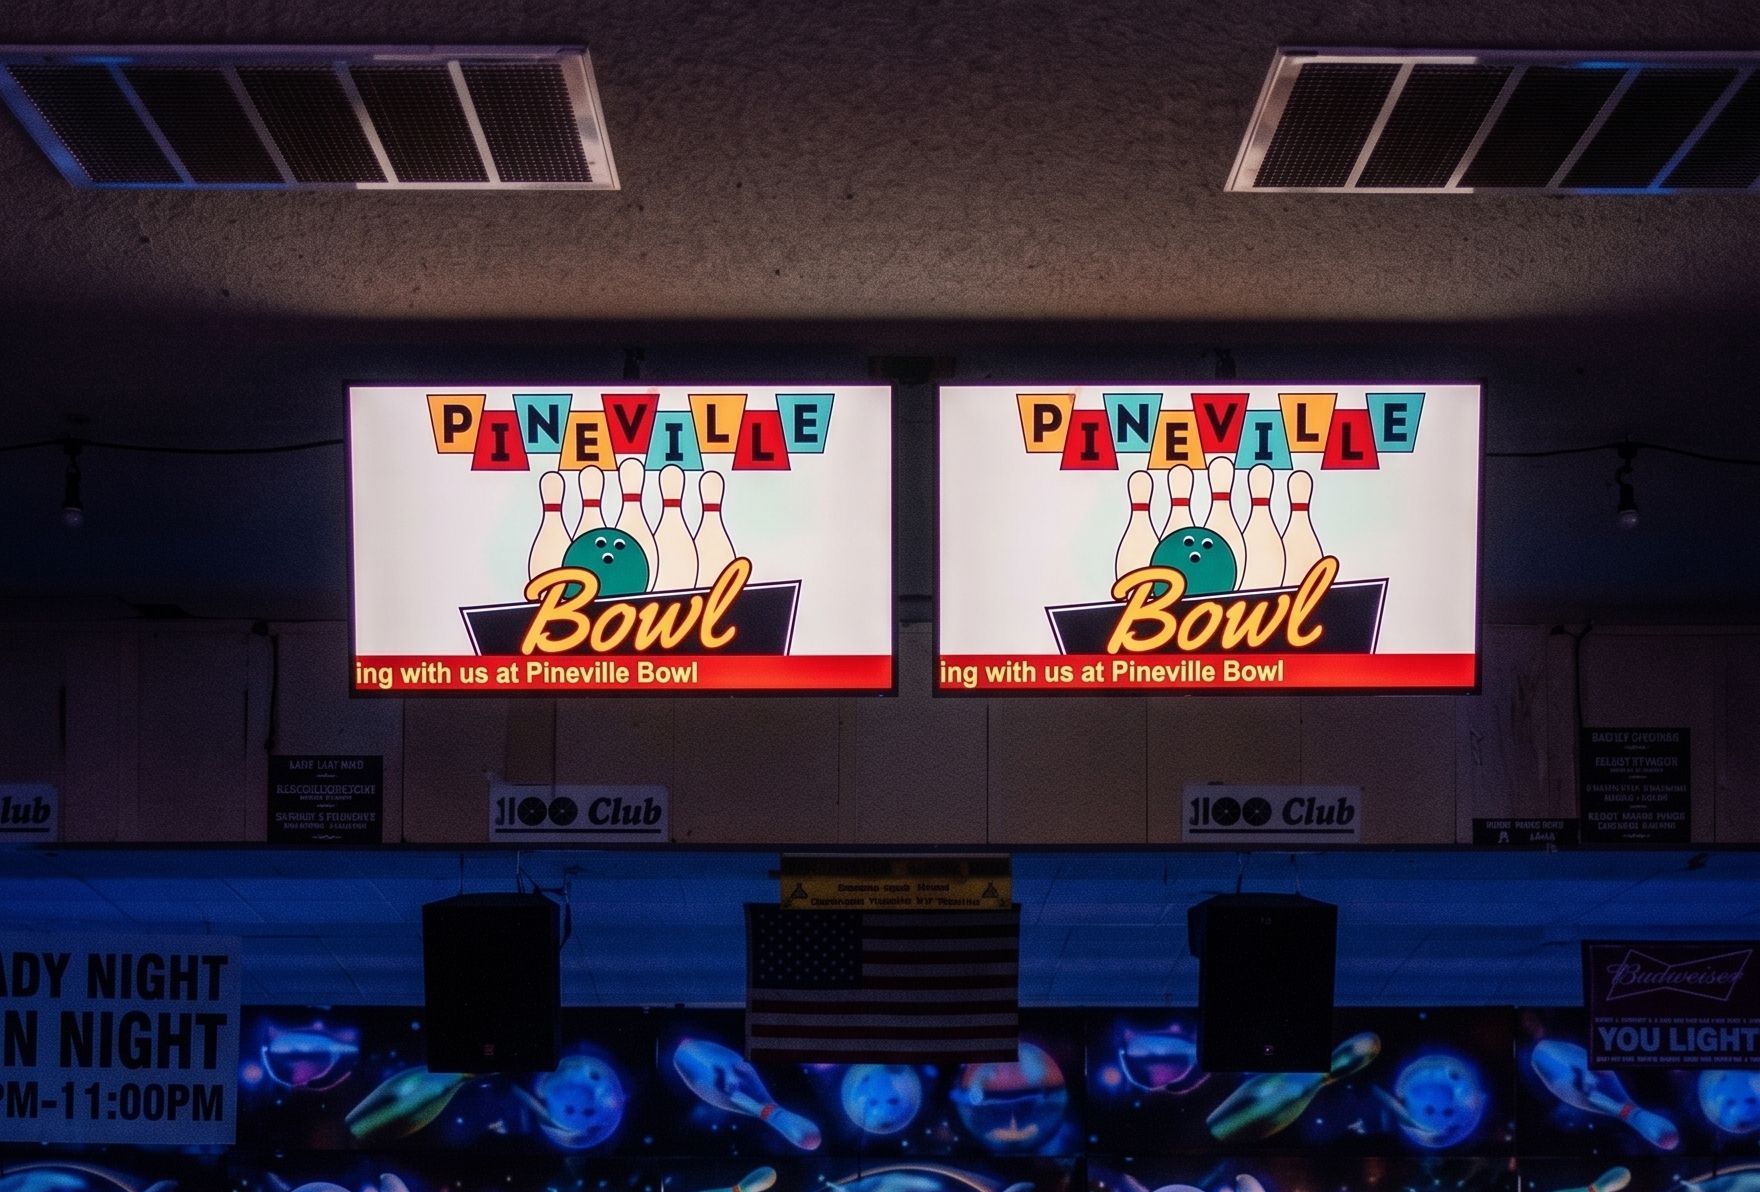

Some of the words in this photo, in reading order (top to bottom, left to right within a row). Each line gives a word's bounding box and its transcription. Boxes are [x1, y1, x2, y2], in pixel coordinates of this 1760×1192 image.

[443, 403, 819, 463] PINEVILLE
[1033, 402, 1408, 462] PINEVILLE
[523, 556, 753, 656] Bowl
[1106, 555, 1340, 655] Bowl
[356, 661, 393, 690] ing
[400, 661, 452, 685] with
[459, 666, 490, 685] us
[496, 662, 520, 685] at
[526, 661, 630, 685] Pineville
[637, 661, 699, 685] Bowl
[940, 660, 978, 689] ing
[985, 660, 1037, 683] with
[1044, 666, 1075, 684] us
[1081, 661, 1105, 684] at
[1111, 660, 1216, 683] Pineville
[1223, 660, 1284, 683] Bowl
[588, 796, 662, 827] Club
[1282, 796, 1355, 827] Club
[87, 952, 229, 1001] NIGHT
[1606, 962, 1744, 985] Budweiser
[60, 1010, 228, 1070] NIGHT
[1597, 1026, 1661, 1052] YOU
[1668, 1026, 1760, 1052] LIGHT
[0, 1080, 223, 1121] M-11:00PM
